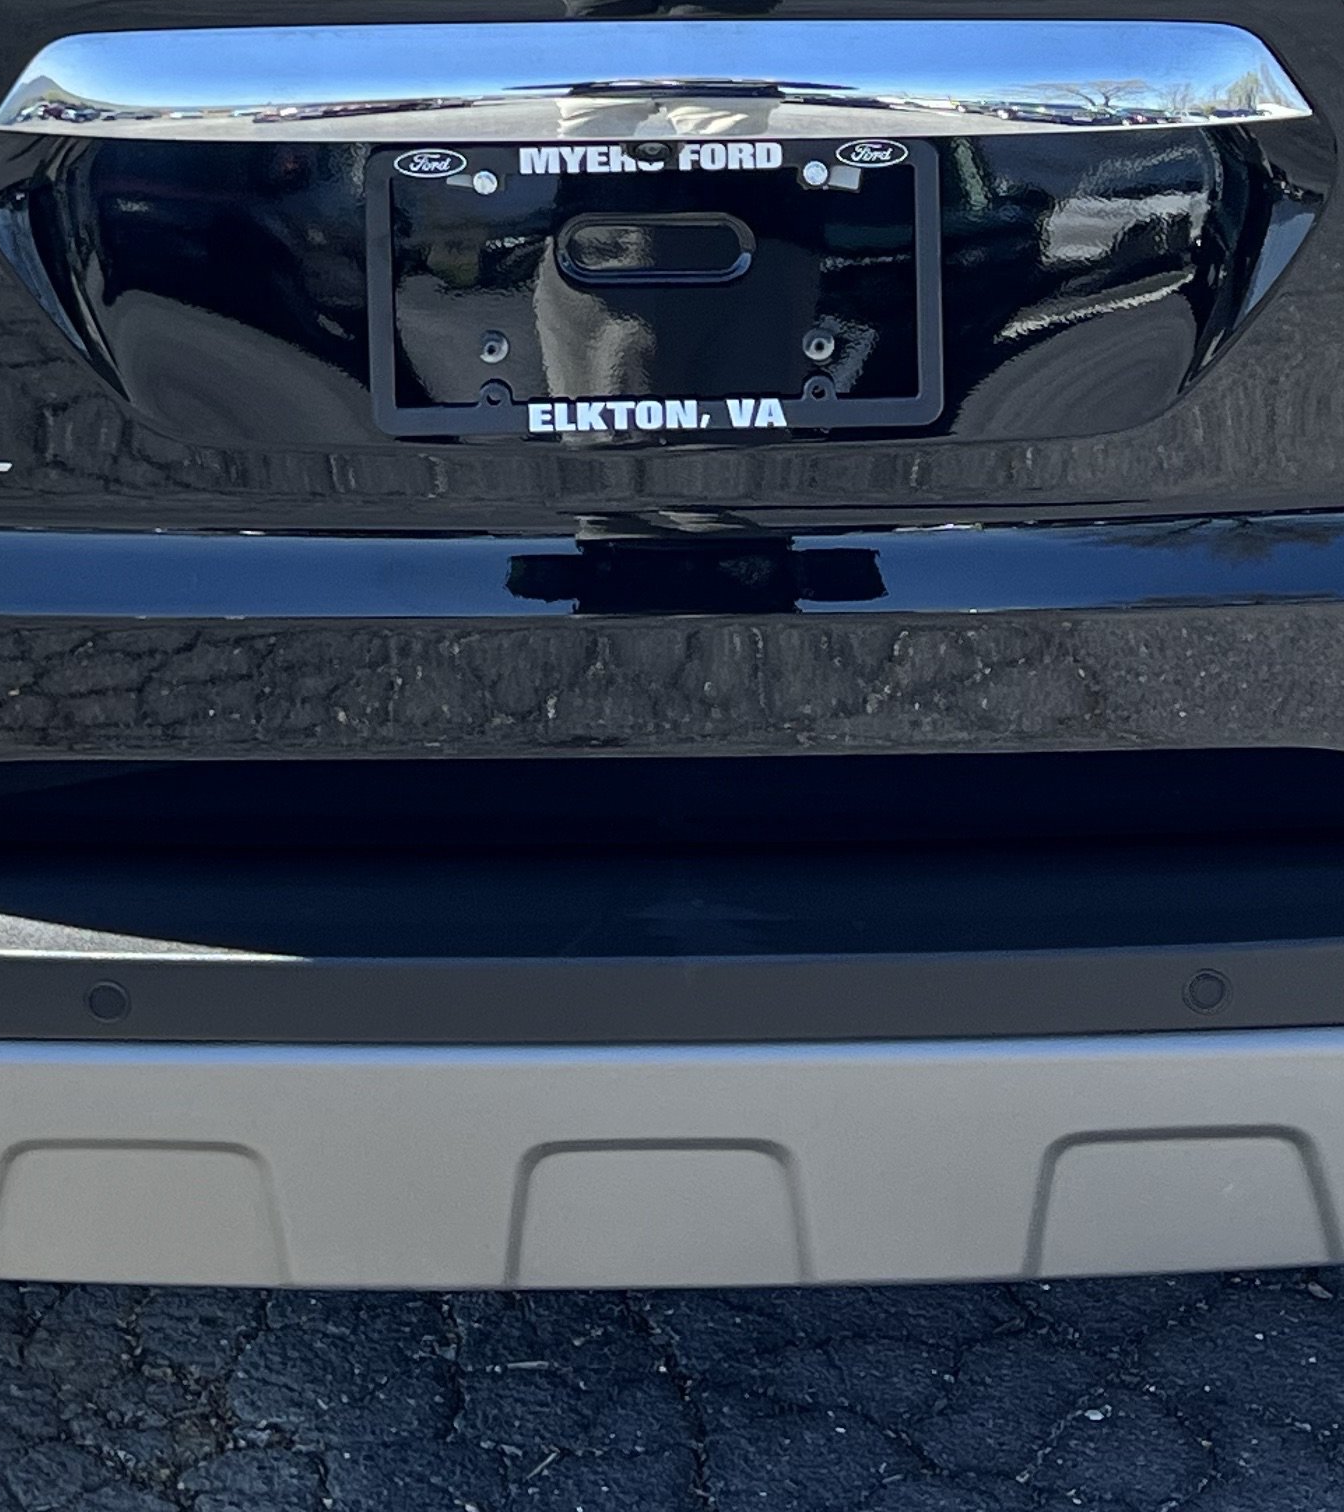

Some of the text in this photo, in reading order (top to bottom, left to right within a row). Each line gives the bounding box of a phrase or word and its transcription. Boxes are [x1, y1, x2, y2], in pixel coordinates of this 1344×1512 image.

[408, 153, 451, 173] Ford
[679, 142, 783, 171] FORD
[850, 143, 893, 162] Ford
[528, 398, 787, 433] ELKTON, VA
